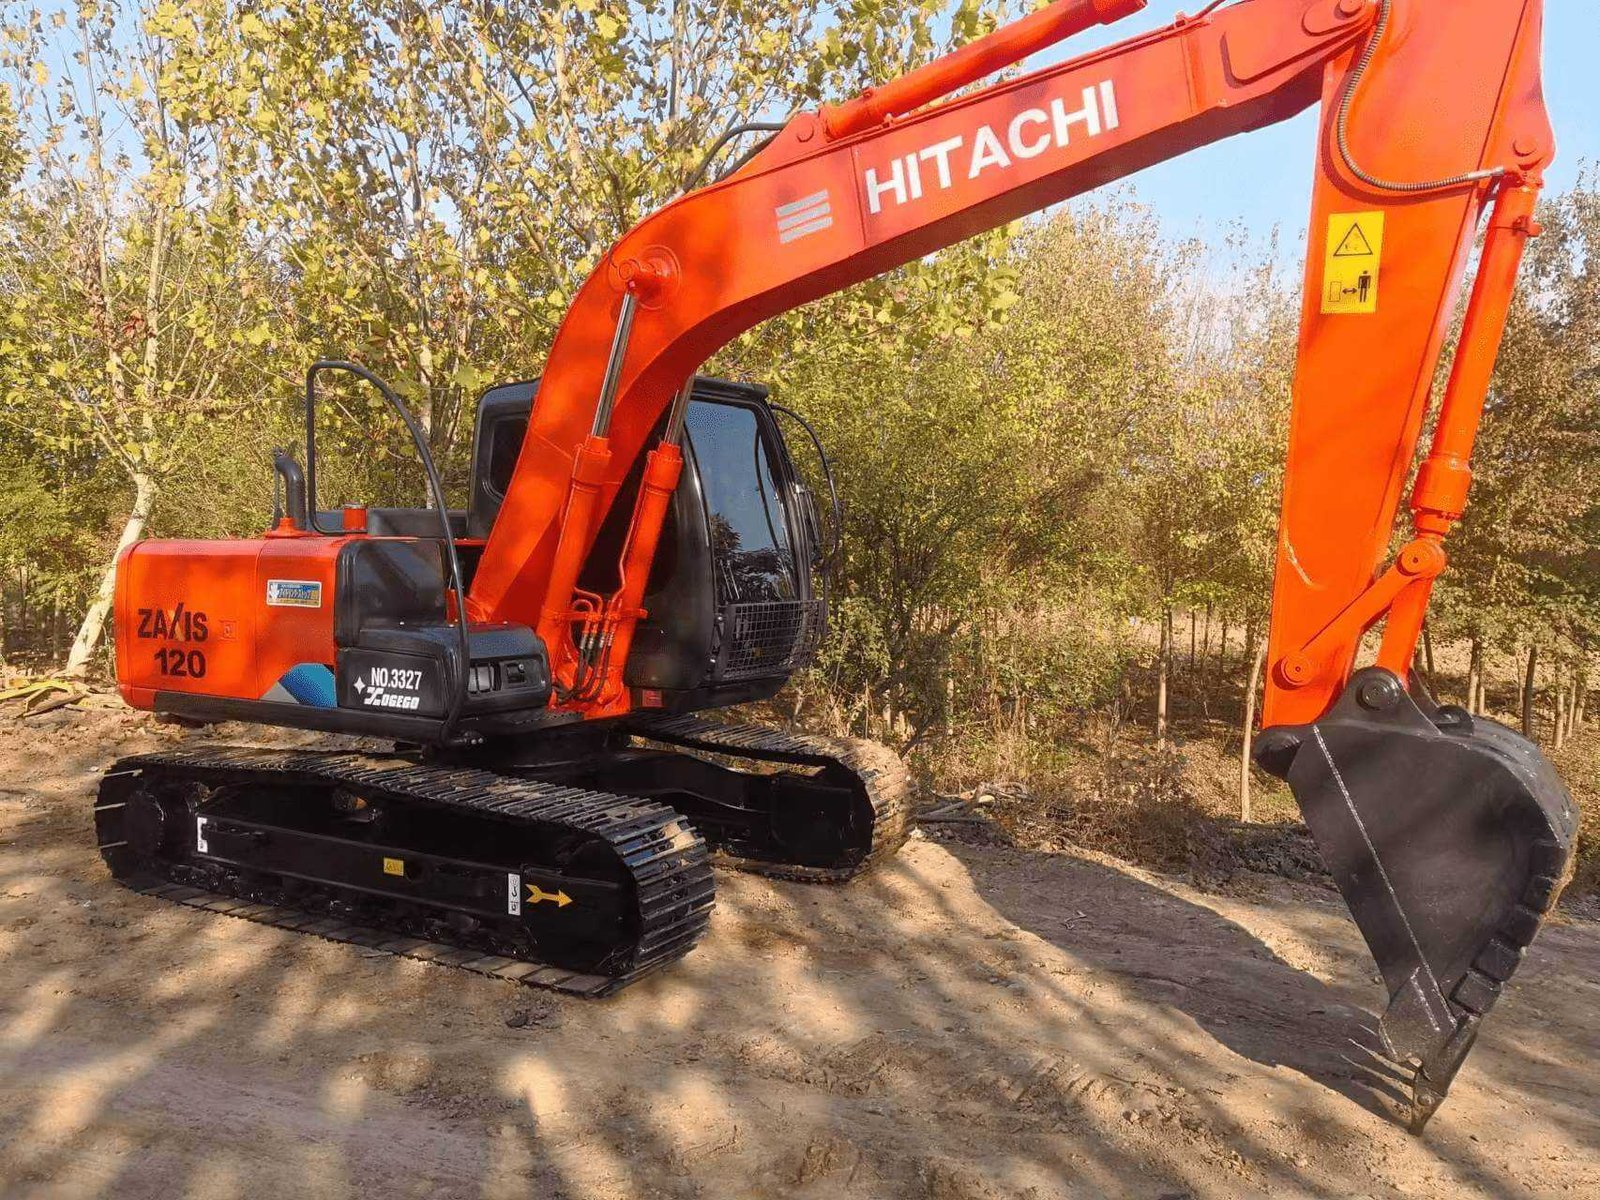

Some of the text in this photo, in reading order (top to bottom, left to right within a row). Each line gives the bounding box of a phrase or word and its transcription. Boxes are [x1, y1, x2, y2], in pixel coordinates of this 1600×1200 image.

[865, 79, 1119, 214] HITACHI
[138, 602, 208, 642] ZAXIS
[154, 647, 206, 678] 120
[371, 667, 422, 690] NO.3327
